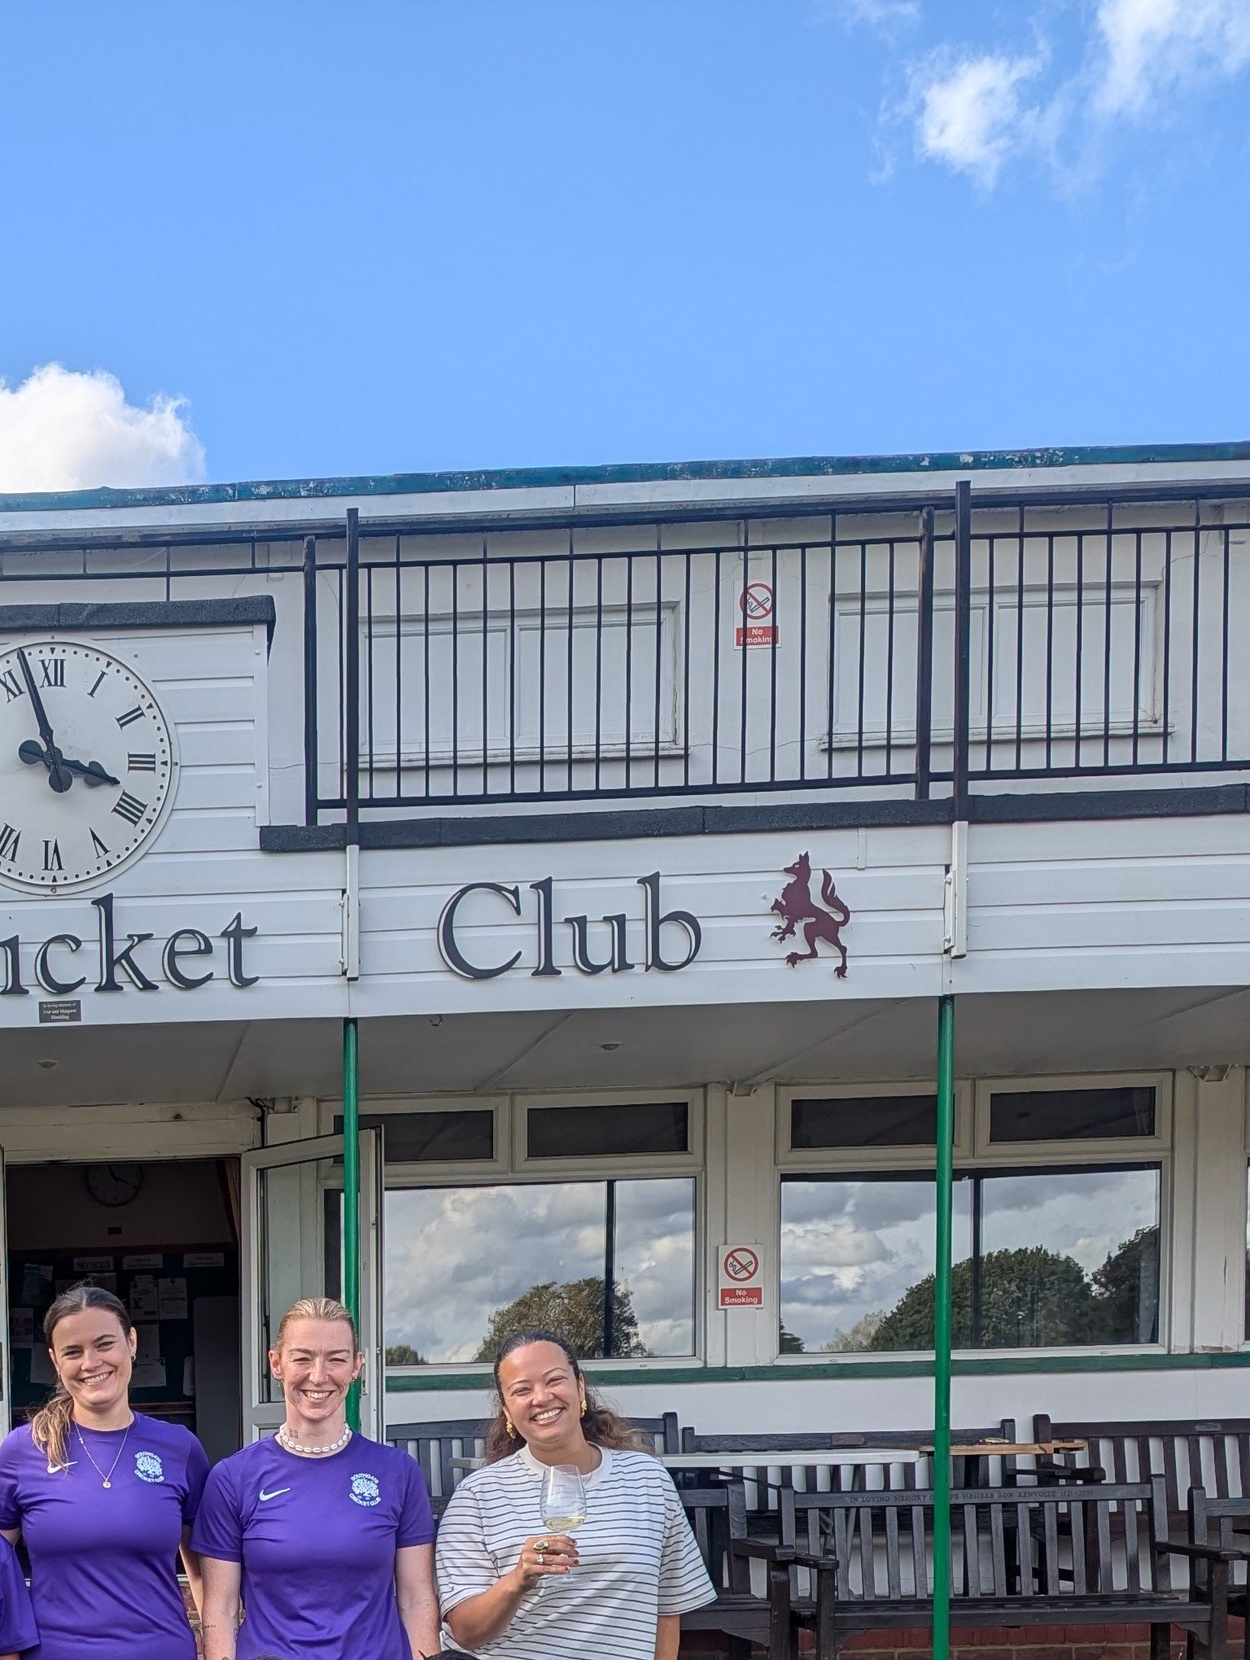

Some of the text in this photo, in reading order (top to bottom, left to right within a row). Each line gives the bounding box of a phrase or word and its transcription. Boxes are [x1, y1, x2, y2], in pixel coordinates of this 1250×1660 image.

[751, 628, 763, 636] No
[437, 871, 702, 980] Club
[725, 1296, 758, 1305] Smoking
